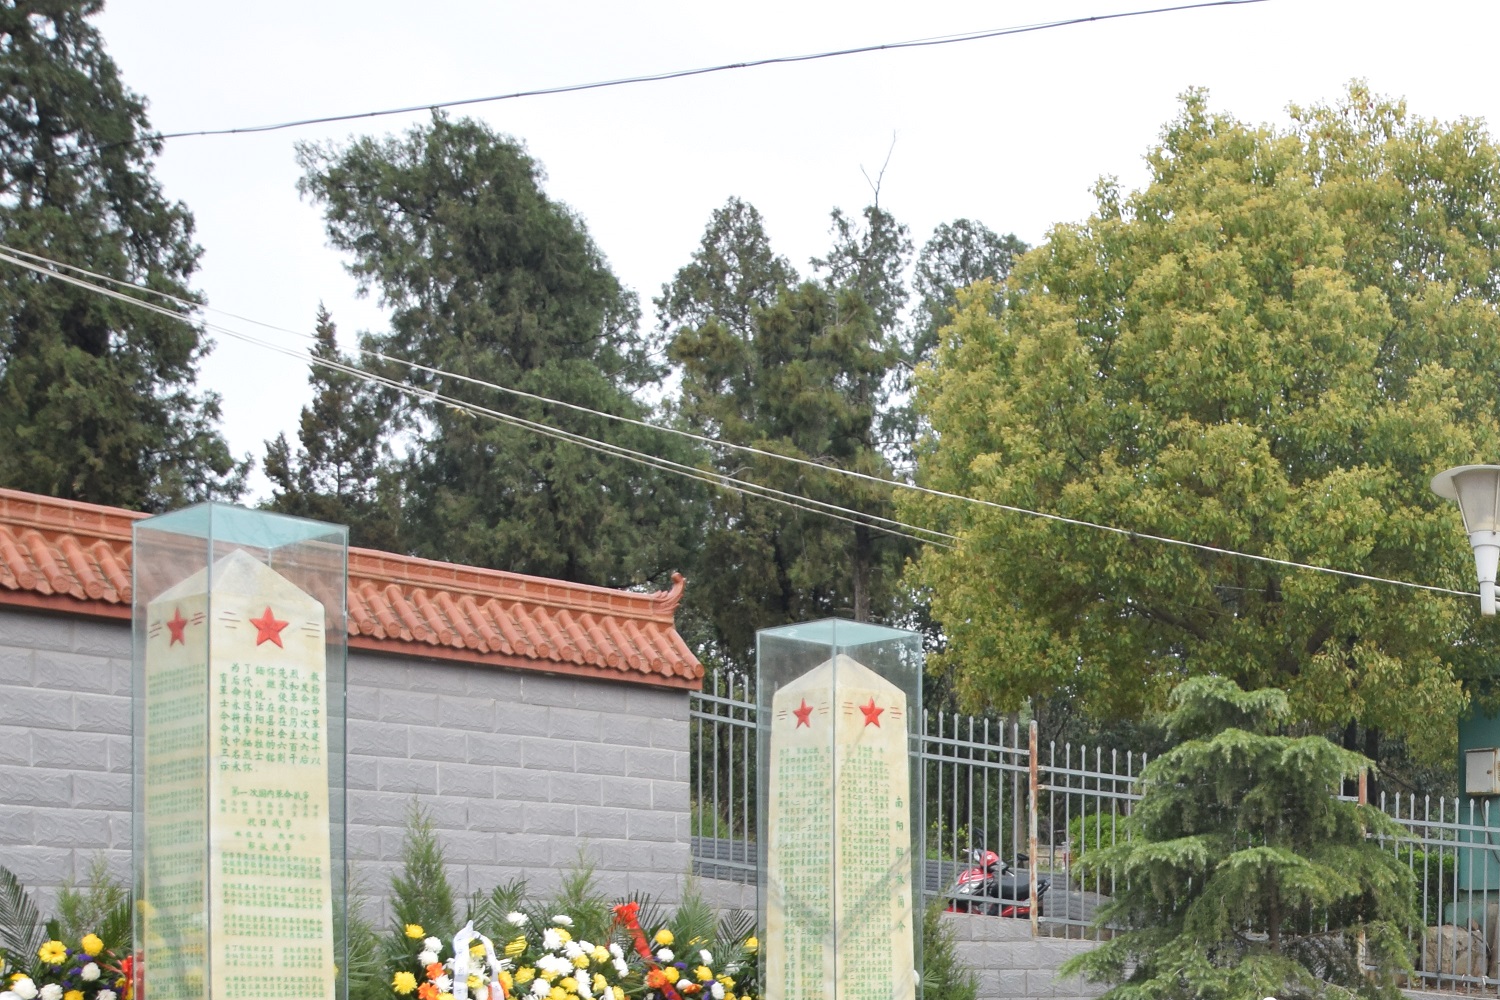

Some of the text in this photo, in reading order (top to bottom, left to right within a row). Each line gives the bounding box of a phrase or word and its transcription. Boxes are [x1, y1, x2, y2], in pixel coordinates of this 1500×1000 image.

[219, 699, 320, 717] 士永远活在我们心中
[894, 795, 906, 934] 南阳解放简介
